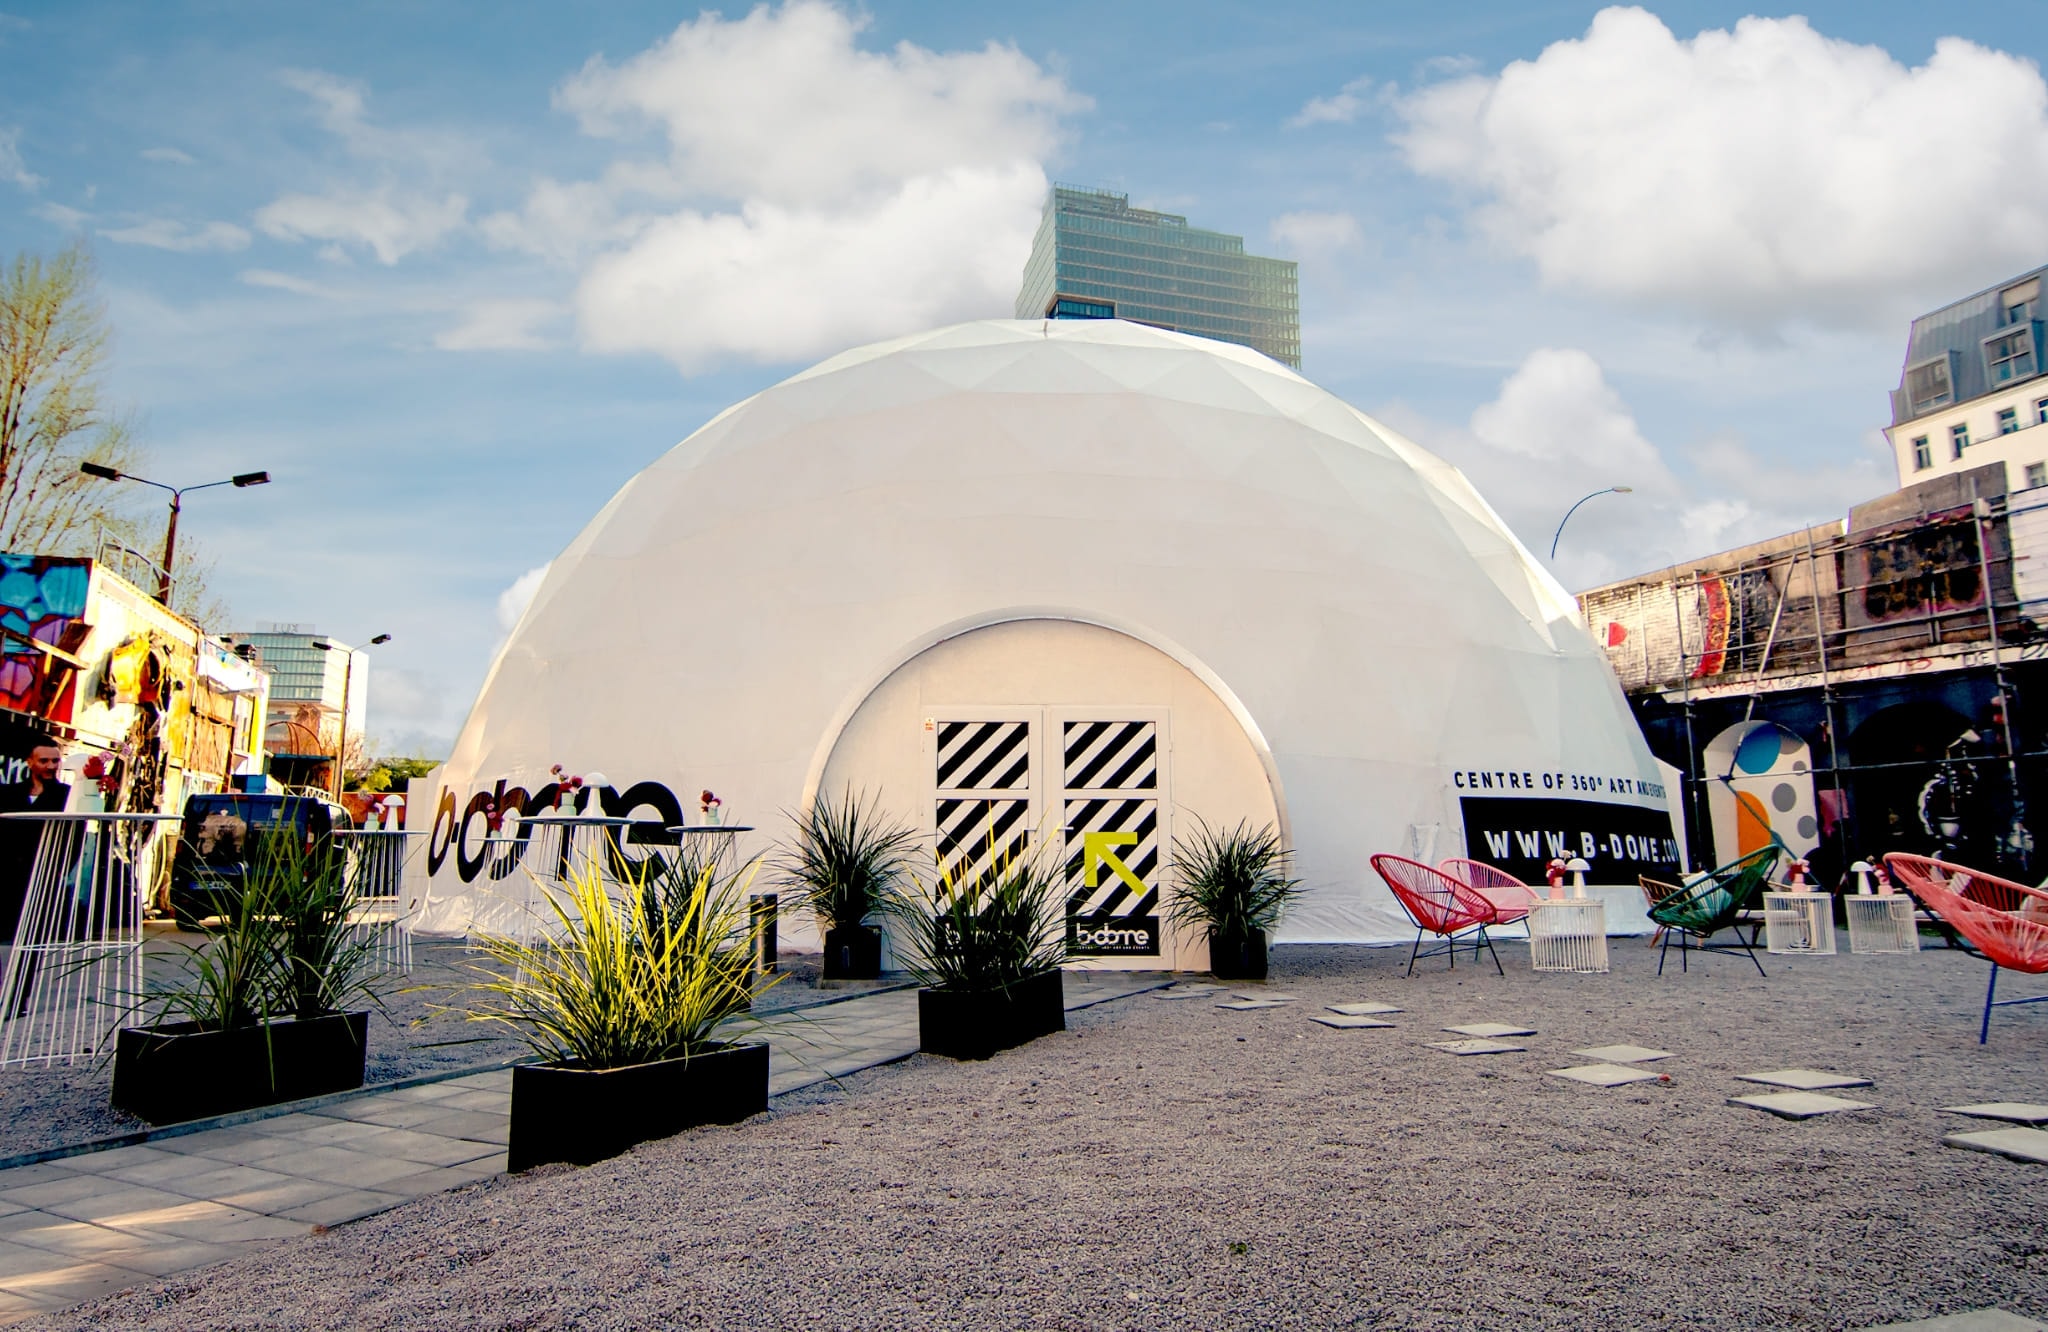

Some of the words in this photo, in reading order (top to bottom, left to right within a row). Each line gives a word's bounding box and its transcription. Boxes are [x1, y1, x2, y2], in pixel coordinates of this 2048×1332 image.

[1454, 771, 1533, 789] CENTRE
[1543, 773, 1564, 789] OF
[1609, 777, 1633, 794] ART
[1076, 922, 1150, 946] b-dome
